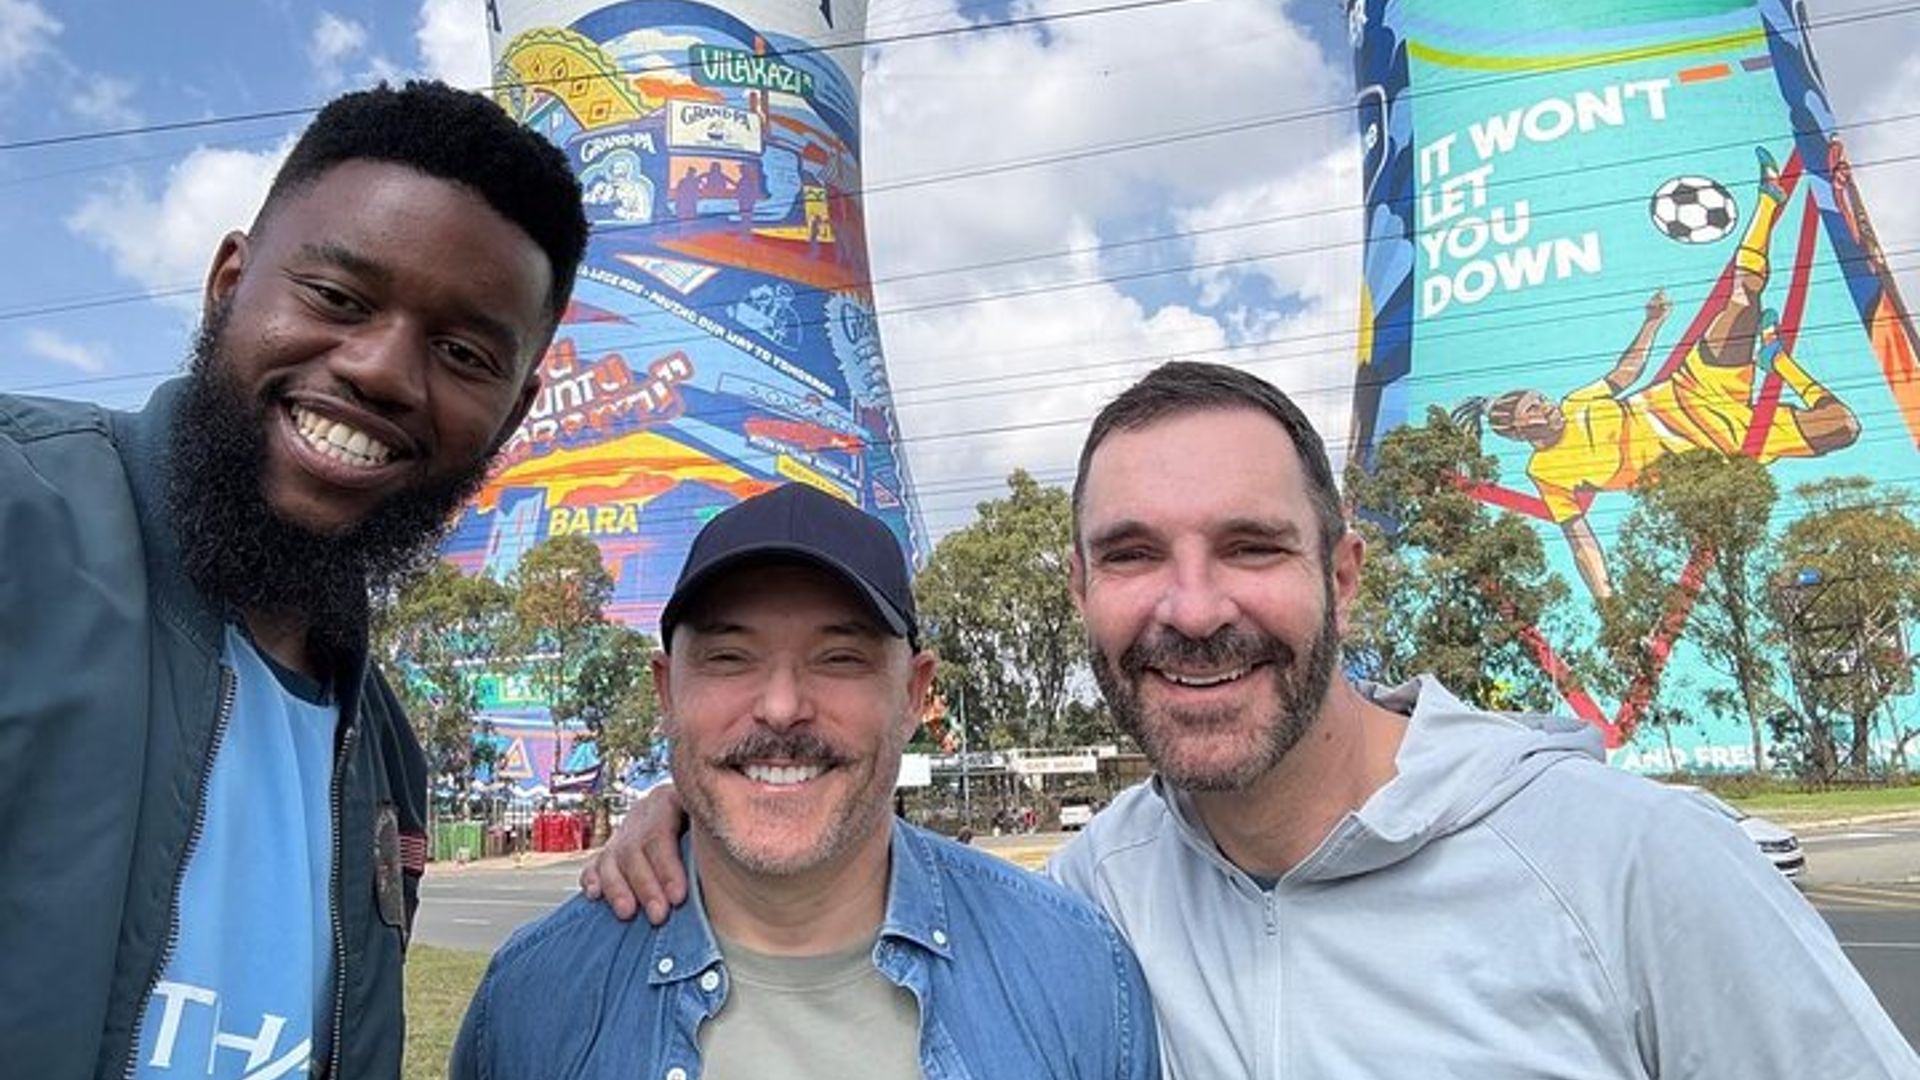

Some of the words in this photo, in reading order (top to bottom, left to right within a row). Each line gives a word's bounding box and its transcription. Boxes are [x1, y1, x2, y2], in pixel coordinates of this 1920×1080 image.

[701, 49, 801, 93] VILAKAZI
[1420, 132, 1457, 186] IT
[1468, 78, 1670, 161] WON'T
[1421, 164, 1494, 228] LET
[1420, 200, 1530, 270] YOU
[1422, 231, 1602, 319] DOWN
[698, 314, 725, 337] OUR
[725, 328, 754, 352] WAY
[754, 344, 772, 363] TO
[549, 505, 639, 537] BARA
[1622, 744, 1687, 770] AND
